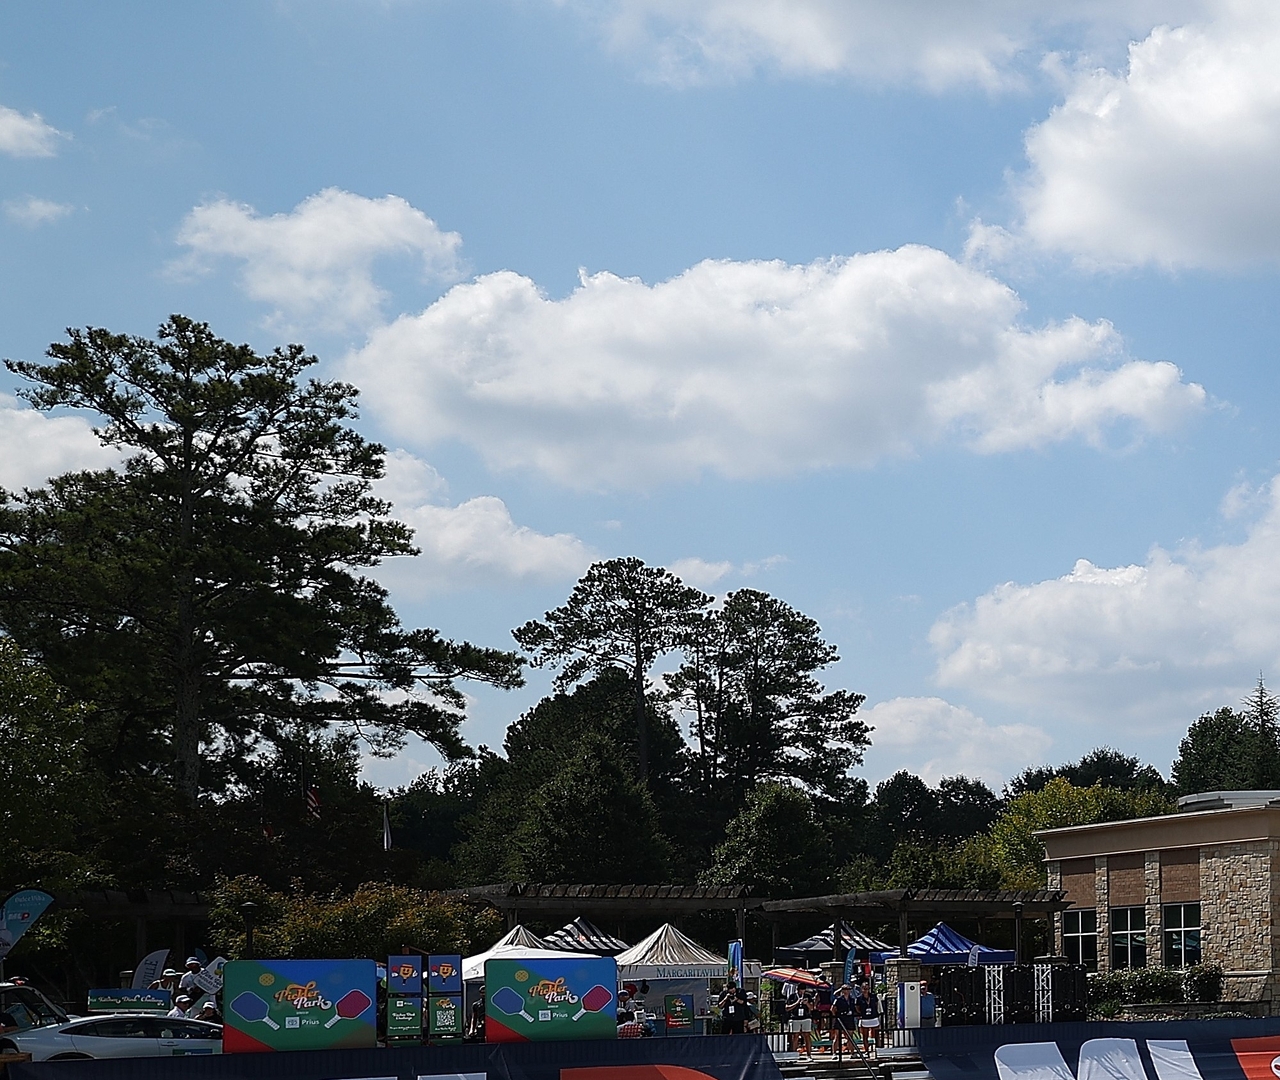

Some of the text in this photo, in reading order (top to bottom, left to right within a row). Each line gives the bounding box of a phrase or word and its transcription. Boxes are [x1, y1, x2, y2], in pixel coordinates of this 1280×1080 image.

[656, 964, 728, 978] MARGARITAVILLE
[293, 995, 333, 1010] Park
[545, 990, 579, 1004] Park
[301, 1018, 320, 1026] Prius
